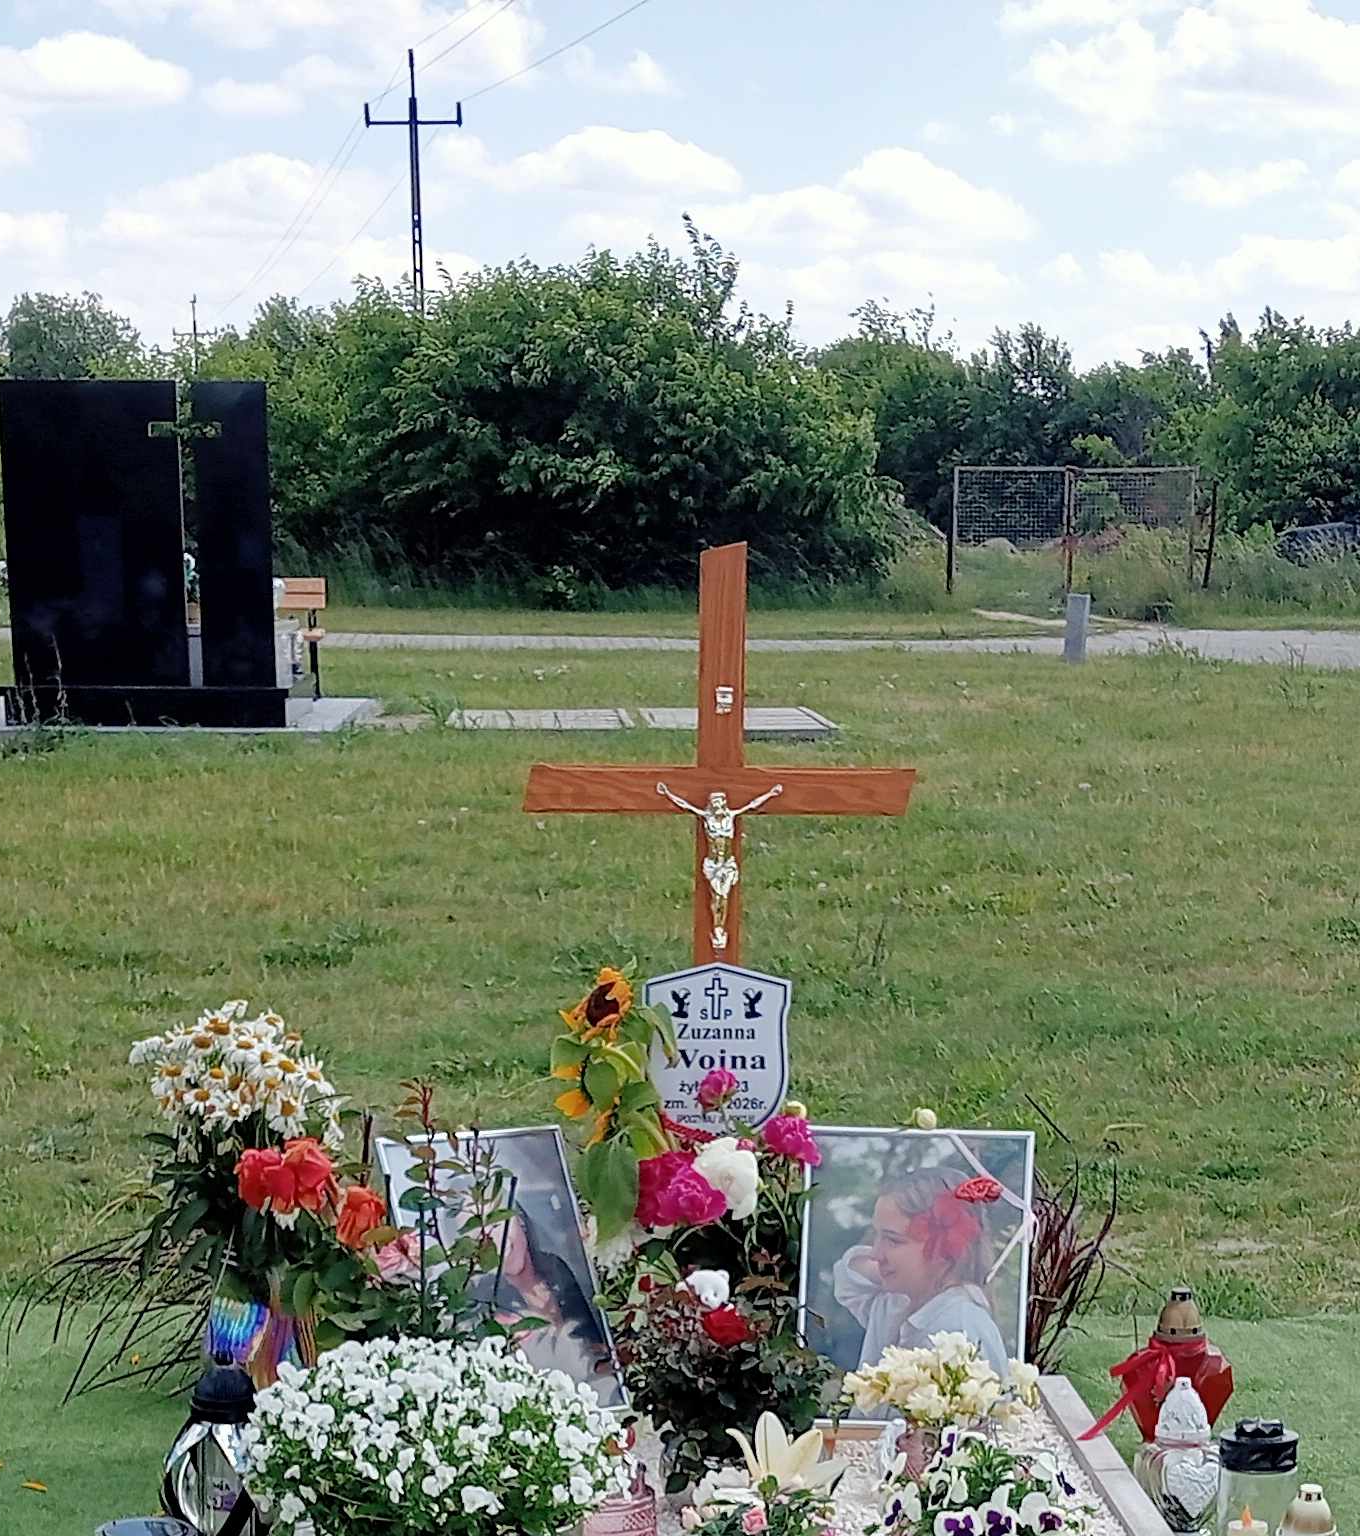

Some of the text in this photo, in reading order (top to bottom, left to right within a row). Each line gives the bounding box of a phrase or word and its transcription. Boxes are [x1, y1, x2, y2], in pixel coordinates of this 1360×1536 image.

[723, 1009, 733, 1020] P
[677, 1023, 756, 1040] Zuzanna
[664, 1099, 687, 1109] zm.
